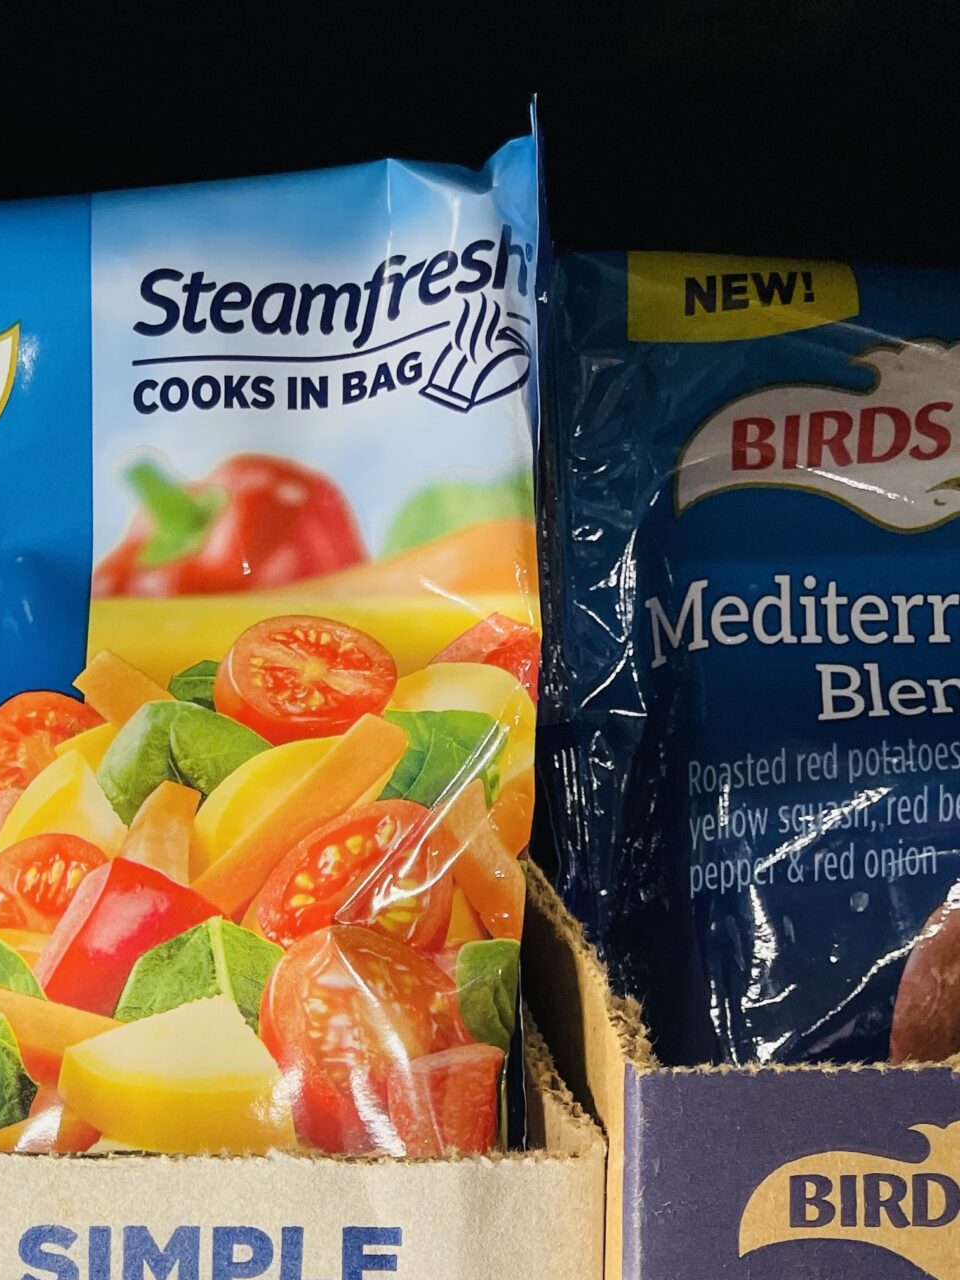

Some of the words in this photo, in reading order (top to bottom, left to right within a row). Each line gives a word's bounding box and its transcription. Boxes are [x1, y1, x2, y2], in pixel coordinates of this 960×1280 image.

[132, 223, 528, 348] Steamfresh
[684, 271, 815, 316] NEW!
[132, 374, 275, 415] COOKS
[287, 375, 329, 411] IN
[342, 351, 422, 405] BAG
[731, 401, 954, 471] BIRDS
[644, 574, 960, 669] Mediterr
[688, 747, 786, 797] Roasted
[796, 742, 838, 783] red
[886, 785, 929, 826] red
[690, 855, 774, 900] pepper
[787, 850, 804, 884] &
[813, 842, 855, 883] red
[863, 838, 938, 879] onion
